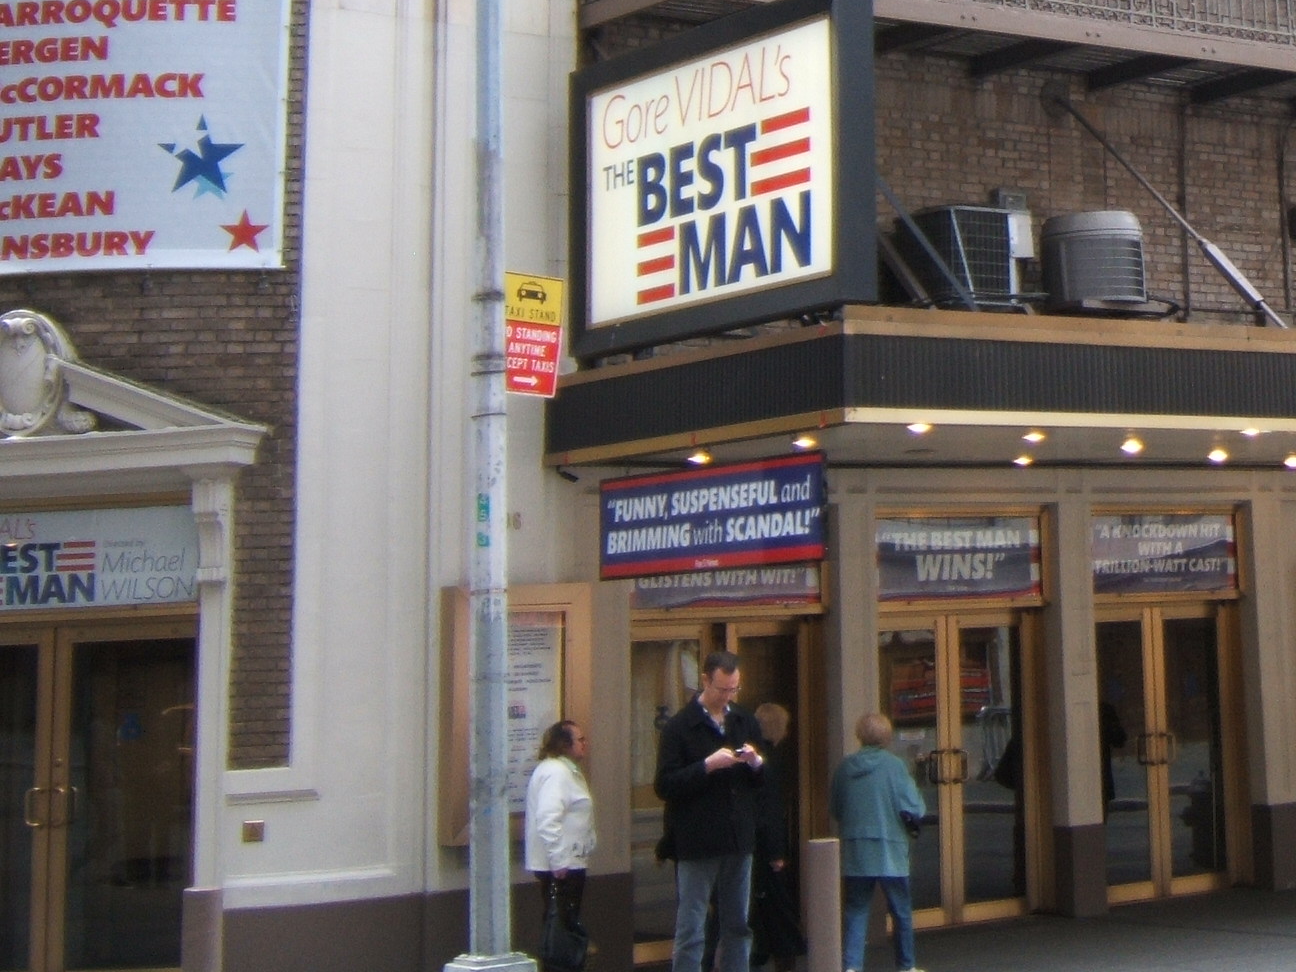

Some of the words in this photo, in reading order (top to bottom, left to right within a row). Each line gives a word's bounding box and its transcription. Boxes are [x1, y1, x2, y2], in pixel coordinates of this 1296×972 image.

[602, 93, 670, 149] Gore
[674, 44, 792, 127] VIDAL's
[603, 159, 634, 192] THE
[636, 122, 757, 228] BEST
[679, 189, 812, 296] MAN
[505, 305, 525, 318] TAXI
[529, 309, 556, 322] STAND
[516, 327, 557, 343] STANDING
[508, 342, 546, 357] ANYTIME
[506, 357, 528, 370] CEPT
[531, 359, 555, 373] TAXIS
[606, 494, 668, 522] "FUNNY,
[671, 480, 778, 516] SUSPENSEFUL
[781, 475, 811, 502] and
[607, 523, 691, 555] BRIMMING
[693, 518, 723, 545] with
[725, 508, 820, 543] SCANDAL!"
[931, 531, 973, 550] BEST
[976, 529, 1020, 548] MAN
[102, 547, 185, 573] Michael
[1138, 541, 1172, 556] WITH
[1174, 542, 1183, 555] A
[638, 571, 712, 589] GLISTENS
[714, 569, 757, 586] WITH
[916, 552, 1005, 582] WINS!"
[6, 573, 95, 605] MAN
[101, 576, 194, 600] WILSON
